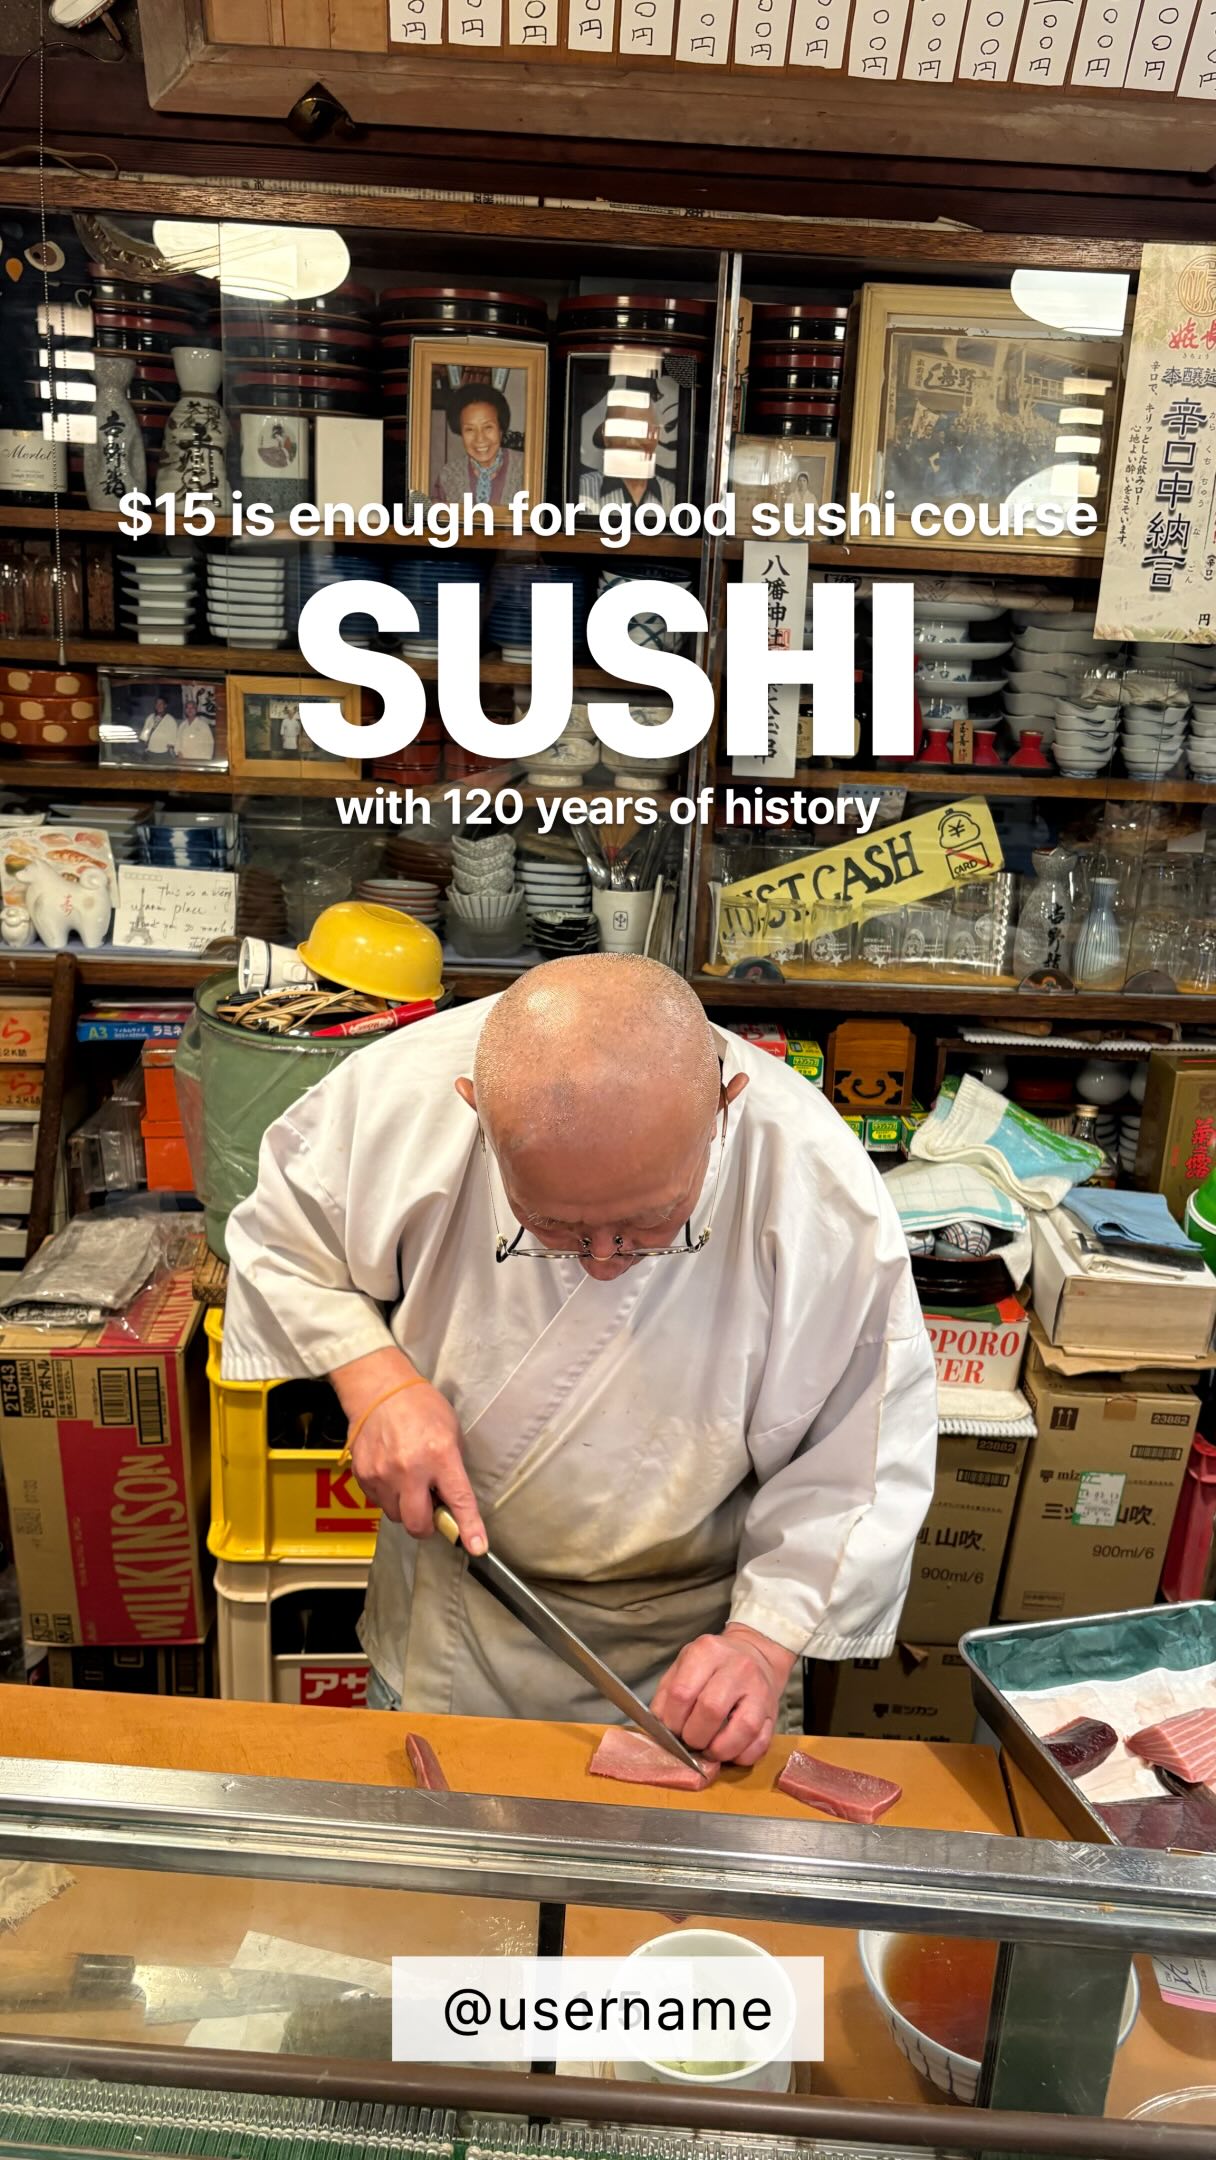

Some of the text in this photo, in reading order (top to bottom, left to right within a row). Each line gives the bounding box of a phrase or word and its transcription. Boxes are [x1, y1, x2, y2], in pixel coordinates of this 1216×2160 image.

[1142, 397, 1208, 588] 辛口中納言
[1198, 613, 1211, 627] 円
[812, 831, 924, 902] CASH
[953, 859, 979, 876] CARD
[2, 1017, 32, 1046] ら
[88, 1026, 109, 1040] A3
[4, 1363, 20, 1412] 2T543
[109, 1453, 195, 1640] WILKINSON
[1092, 1543, 1155, 1561] 900ml/6
[920, 1566, 985, 1585] 900ml/6
